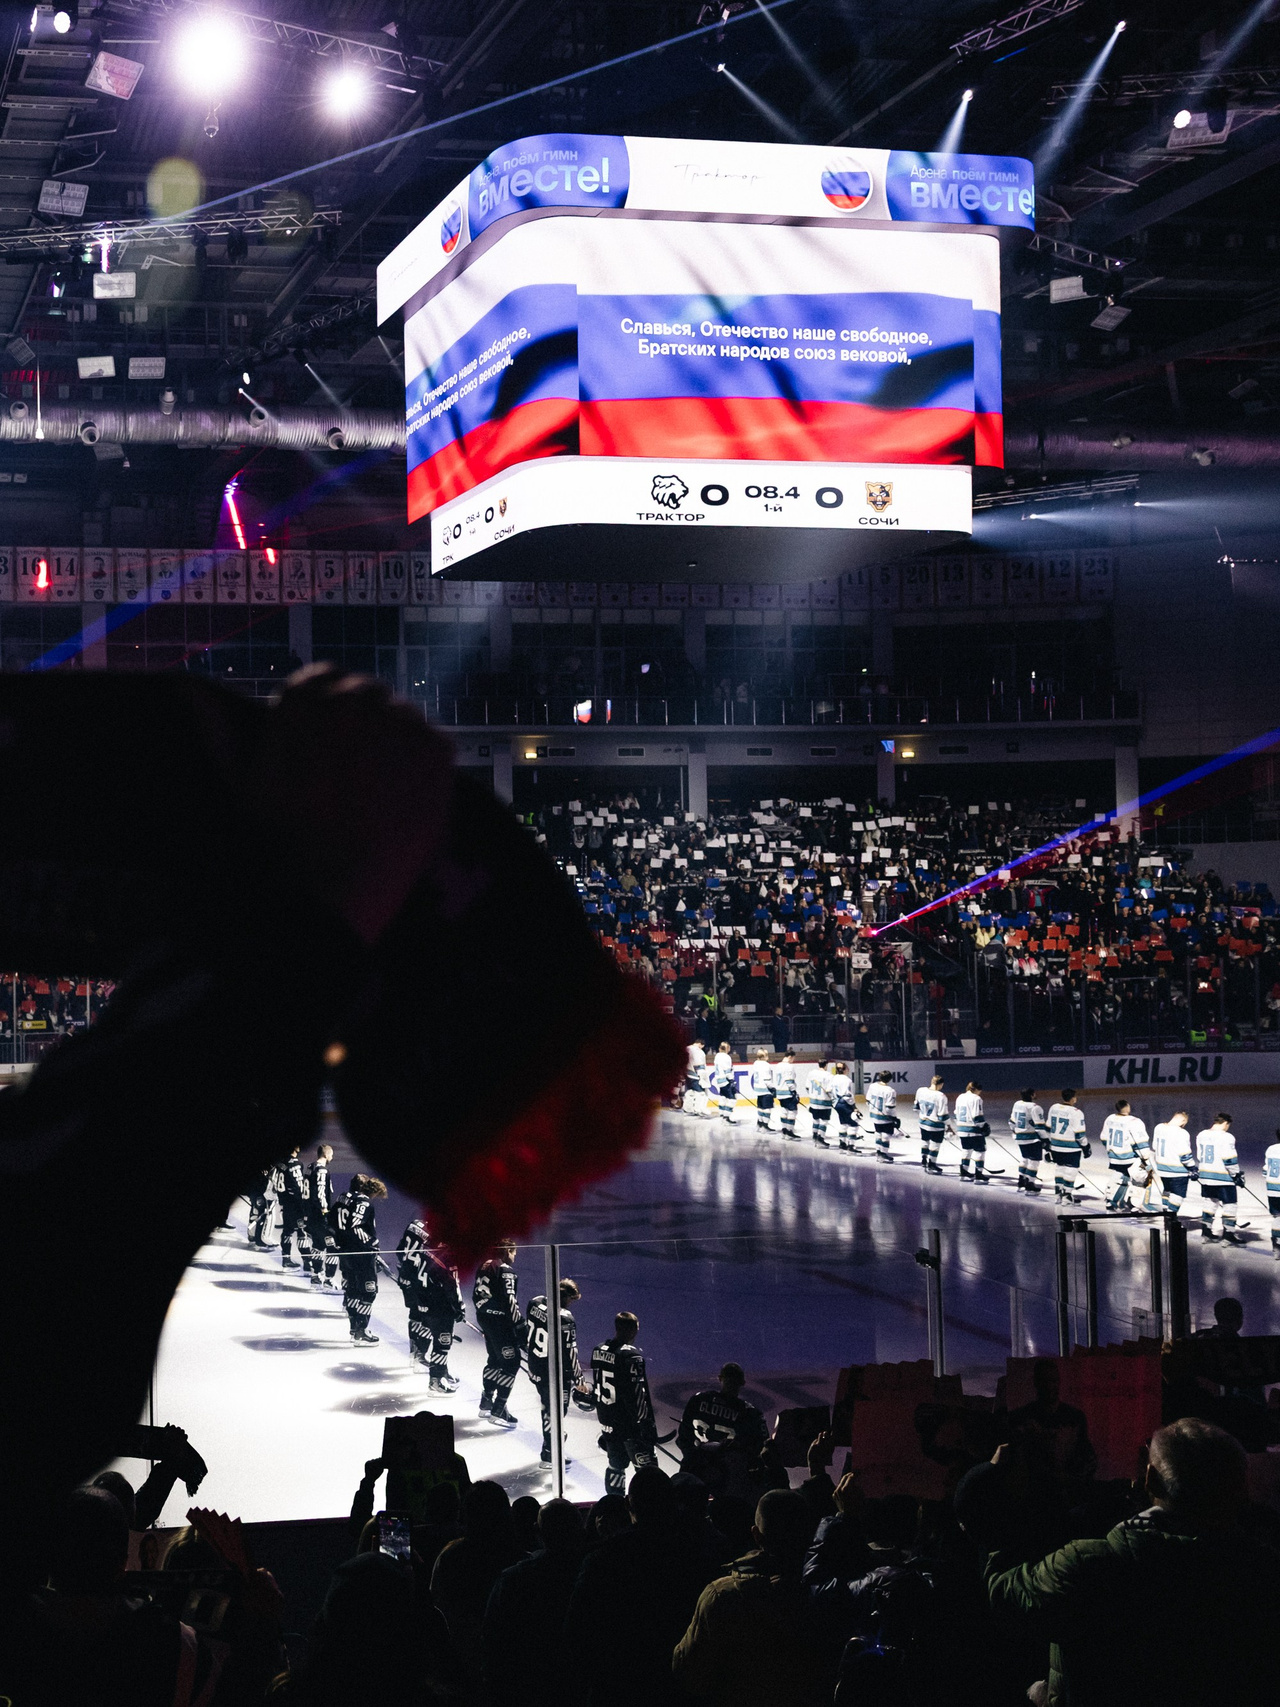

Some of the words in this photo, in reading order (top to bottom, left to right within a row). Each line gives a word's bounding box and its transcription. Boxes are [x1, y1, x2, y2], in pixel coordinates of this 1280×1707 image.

[503, 151, 540, 172] поём
[542, 150, 578, 162] гимн
[909, 164, 948, 180] Арена
[952, 168, 985, 182] поём
[989, 171, 1019, 183] гимн
[620, 318, 696, 338] Славься,
[700, 321, 789, 340] Отечество
[792, 327, 836, 341] наше
[840, 327, 934, 346] свободное,
[637, 339, 717, 358] Братских
[720, 345, 791, 361] народов
[794, 347, 836, 361] союз
[840, 347, 913, 366] вековой,
[423, 374, 458, 406] Отечество
[459, 359, 478, 381] наше
[478, 327, 531, 366] свободное,
[406, 412, 431, 440] ратских
[431, 391, 459, 418] народов
[460, 378, 478, 399] союз
[479, 350, 514, 385] вековой,
[744, 485, 800, 500] 08.4
[636, 512, 706, 522] ТРАКТОР
[763, 503, 783, 513] 1-й
[858, 517, 900, 526] СОЧИ
[493, 524, 516, 541] СОЧИ
[55, 557, 75, 576] 14
[324, 560, 335, 579] 5
[383, 561, 404, 579] 10
[1105, 1056, 1223, 1085] KHL.RU
[699, 1400, 740, 1422] GLOTOV
